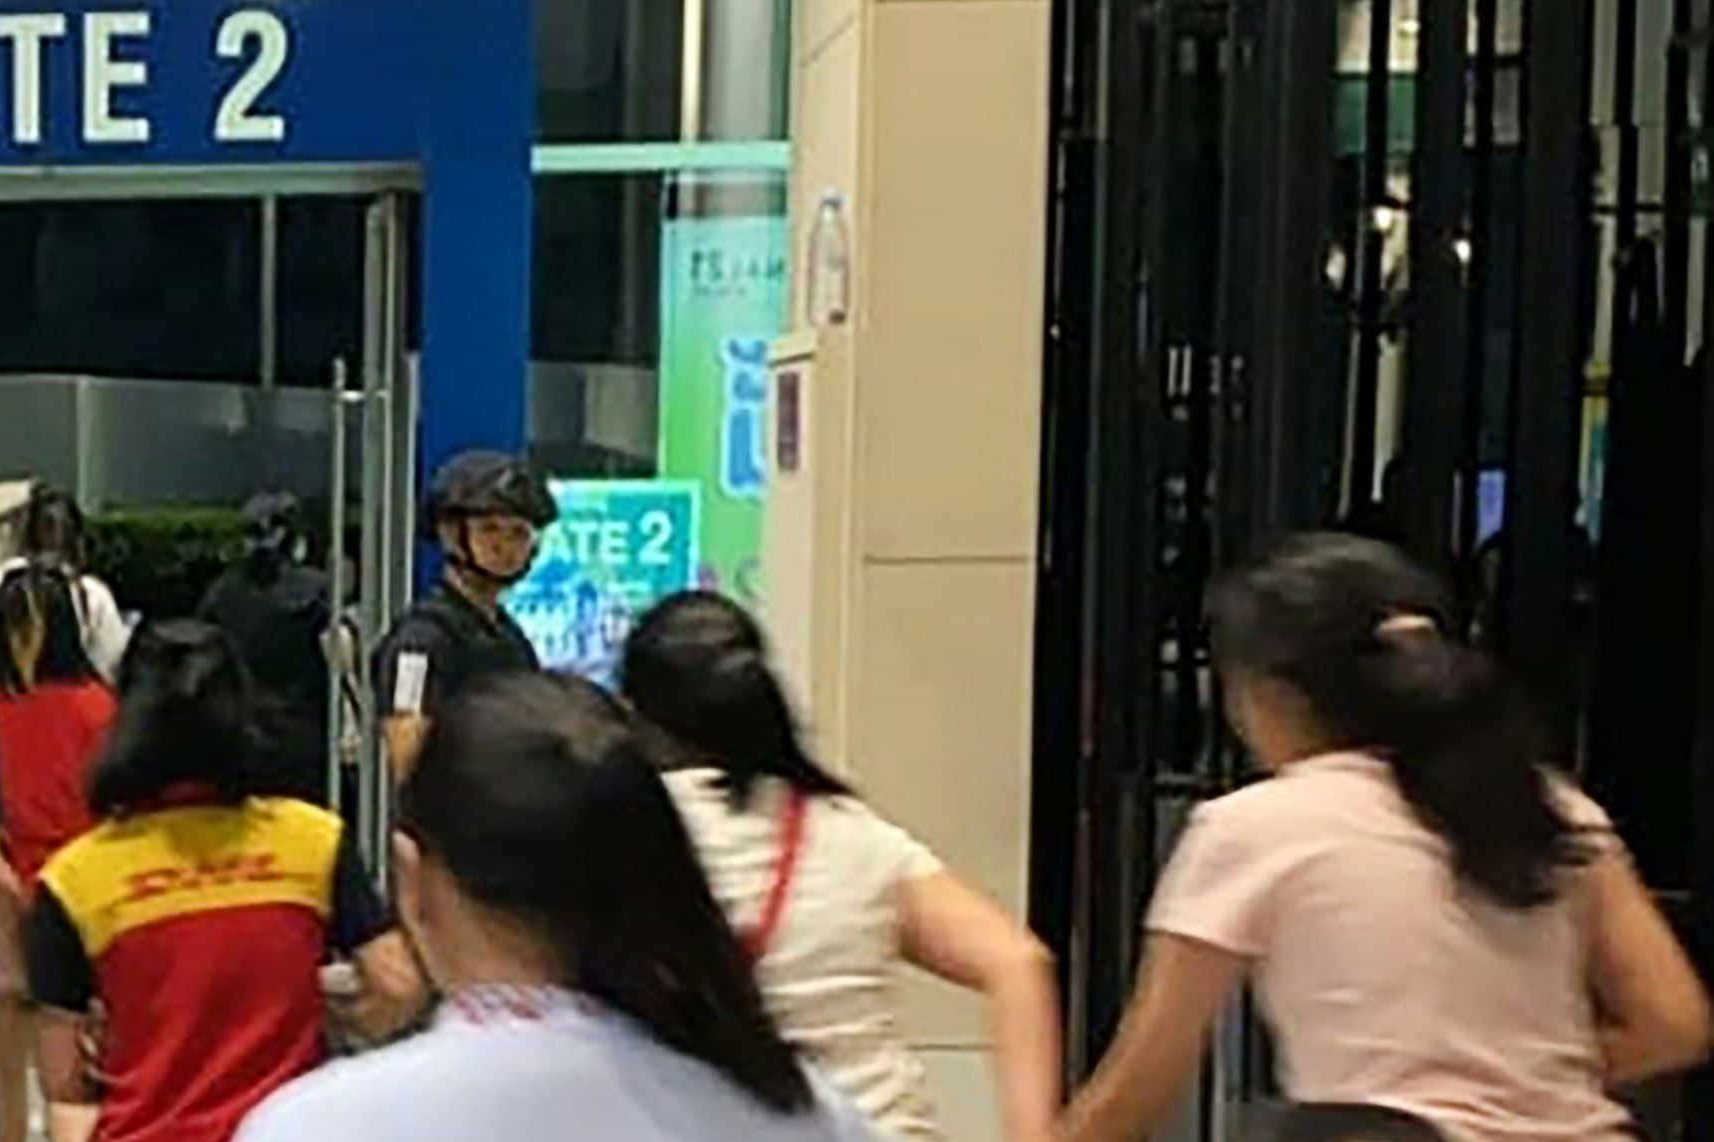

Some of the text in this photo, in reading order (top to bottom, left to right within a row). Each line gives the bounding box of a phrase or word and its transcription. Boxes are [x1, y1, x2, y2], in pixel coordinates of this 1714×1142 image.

[214, 9, 287, 141] 2
[540, 509, 673, 565] ATE 2
